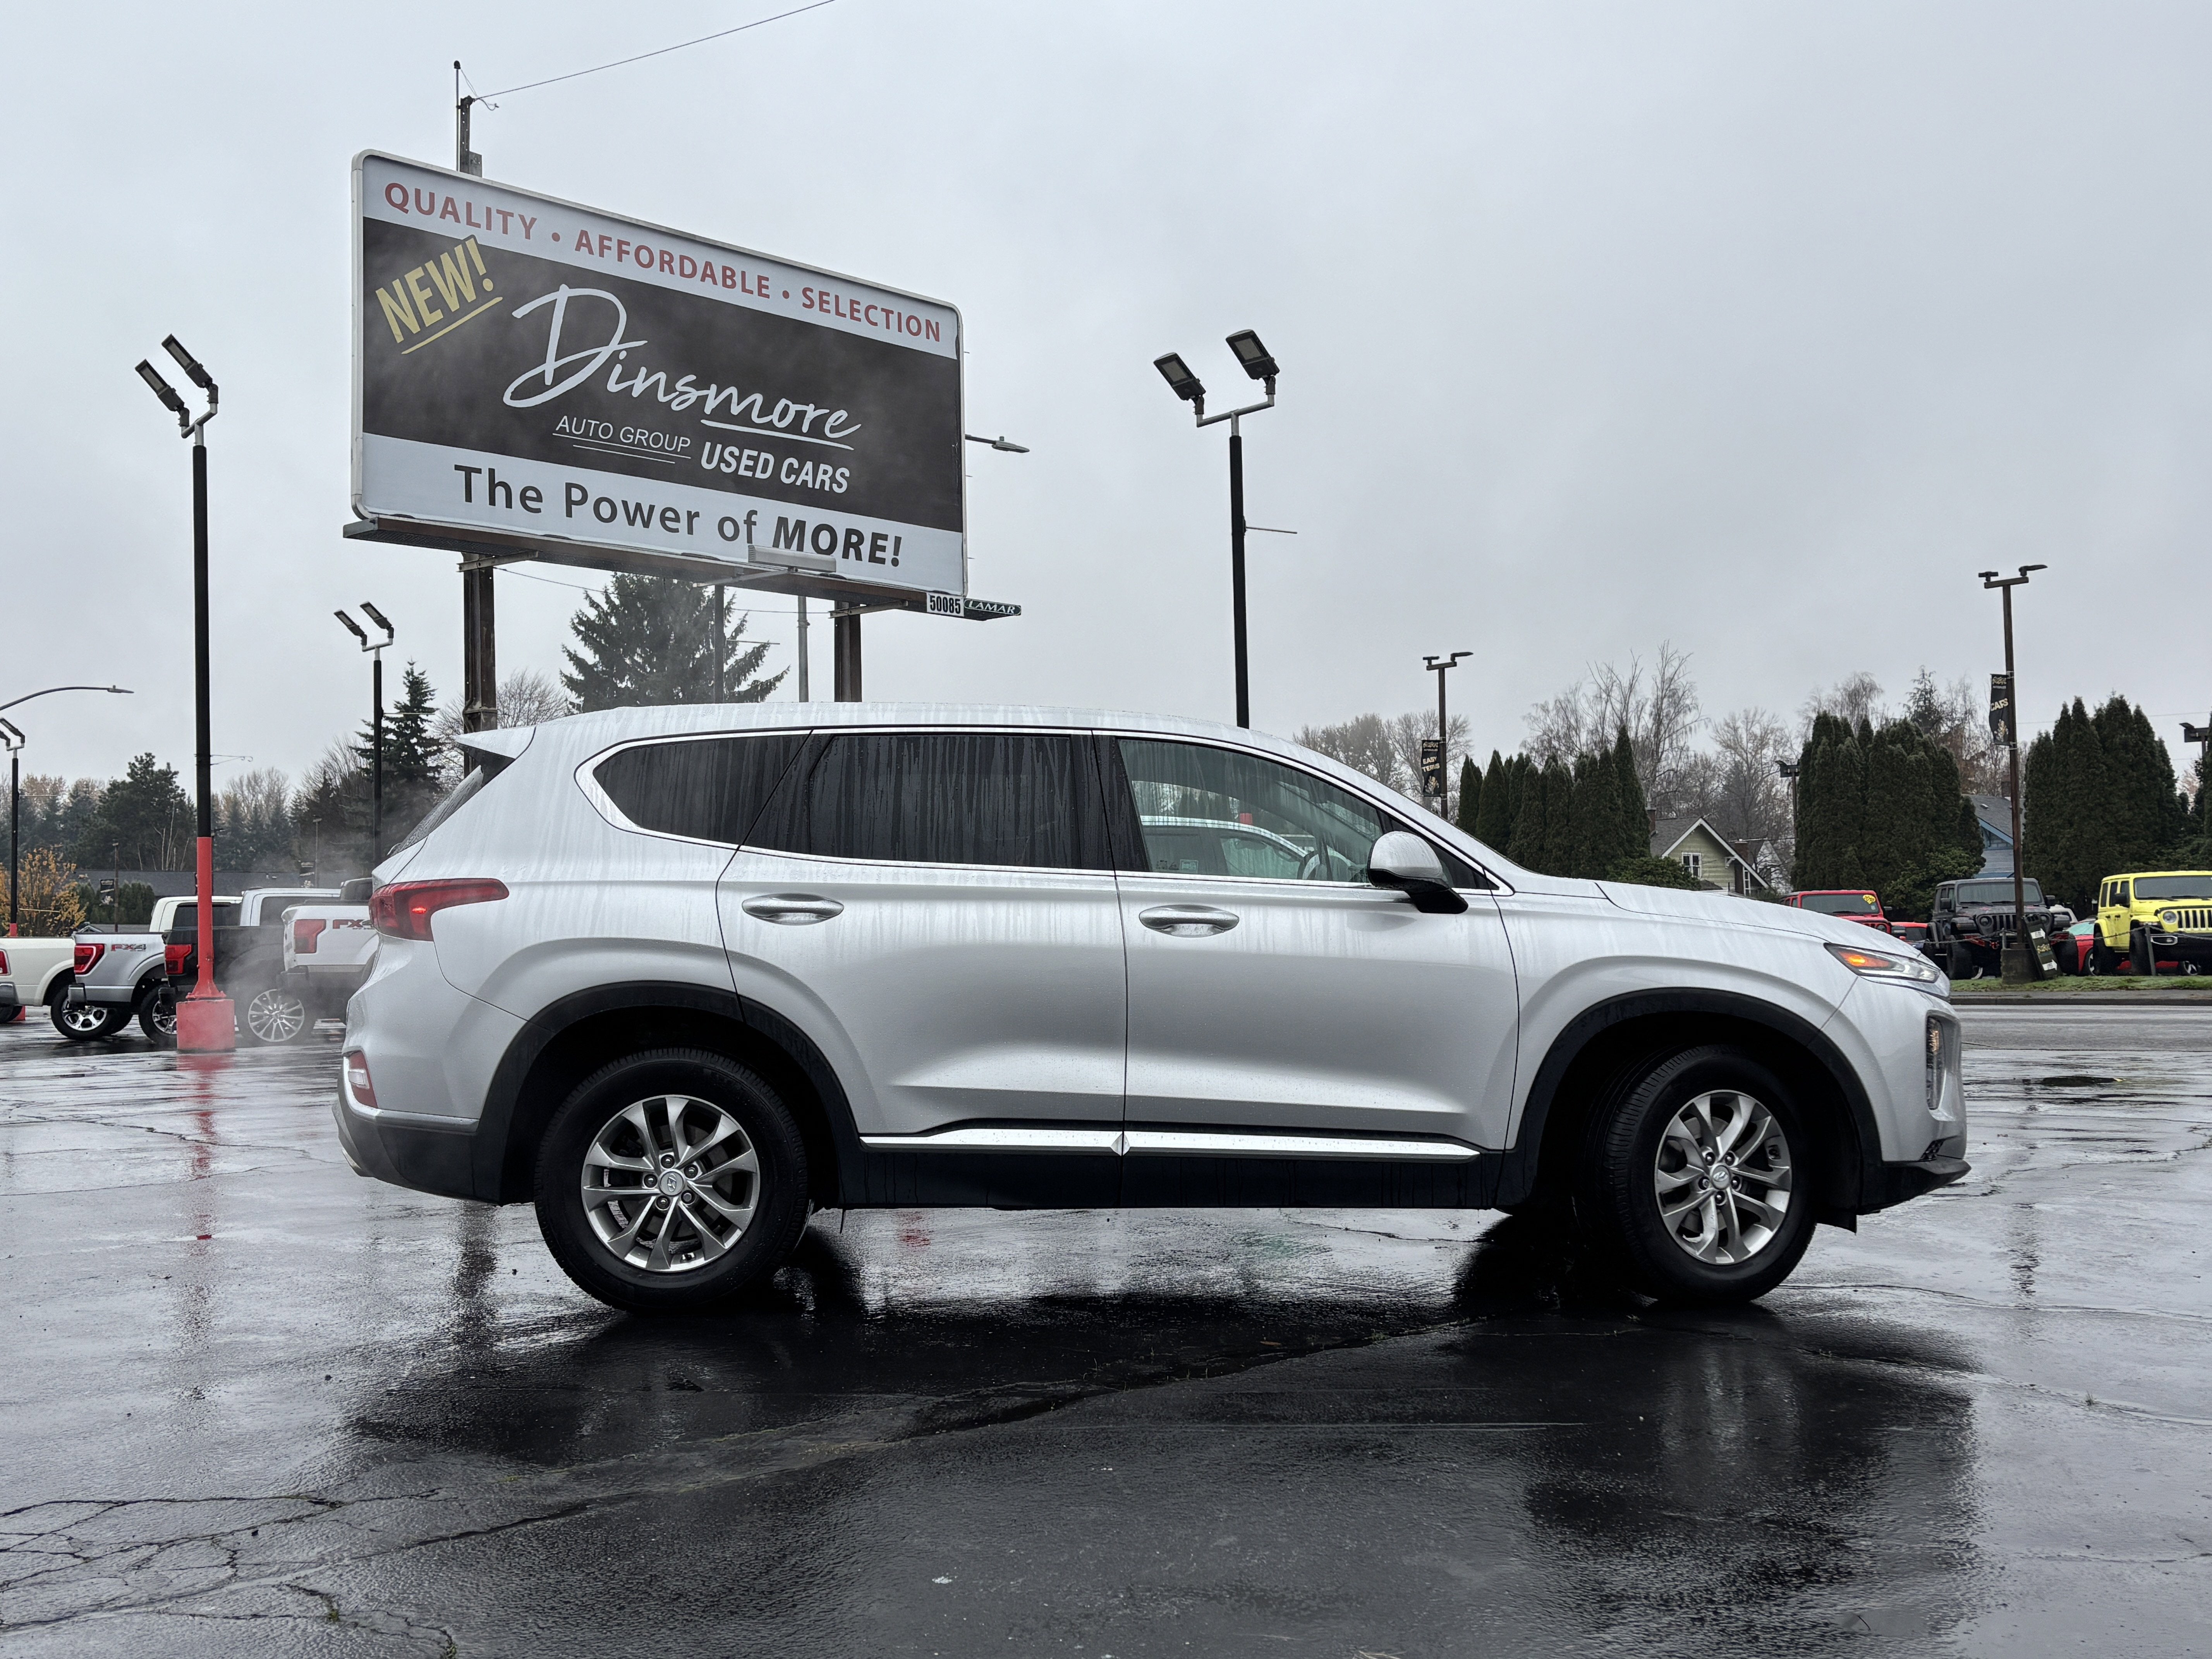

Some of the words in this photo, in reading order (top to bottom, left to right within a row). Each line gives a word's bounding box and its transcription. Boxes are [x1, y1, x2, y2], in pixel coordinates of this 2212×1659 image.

[376, 238, 494, 343] NEW!
[385, 182, 537, 240] QUALITY
[575, 230, 770, 299] AFFORDABLE
[802, 287, 940, 342] SELECTION
[503, 284, 861, 438] Dinsmore
[556, 416, 614, 439] AUTO
[620, 426, 691, 452] GROUP
[701, 441, 775, 479] USED
[780, 457, 850, 493] CARS
[454, 464, 543, 514] The
[565, 482, 700, 535] Power
[718, 510, 758, 544] of
[772, 516, 902, 567] MORE!
[930, 596, 960, 614] 50085
[969, 601, 1015, 614] LAMAR
